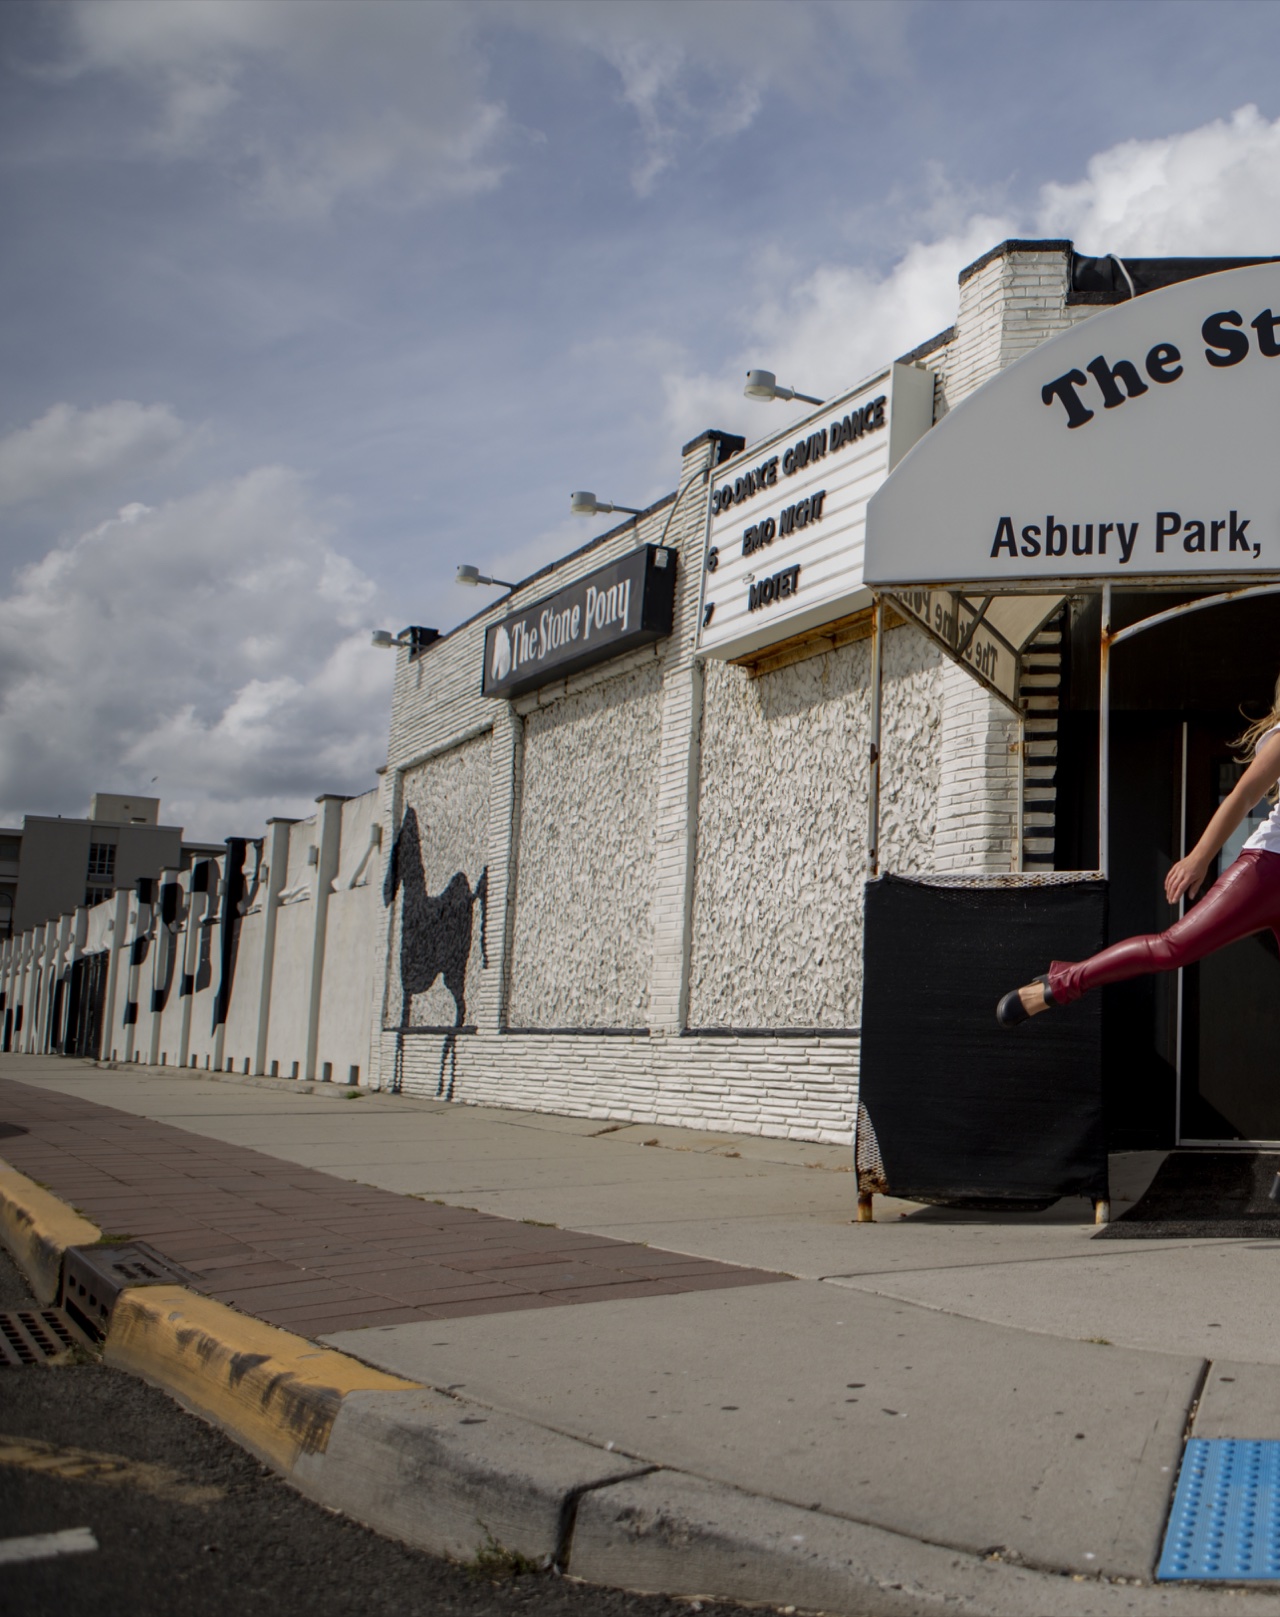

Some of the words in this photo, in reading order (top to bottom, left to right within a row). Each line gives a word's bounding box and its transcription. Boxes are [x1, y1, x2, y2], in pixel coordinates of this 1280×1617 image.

[1041, 343, 1184, 429] The
[782, 428, 827, 476] GAVIN
[830, 395, 887, 450] DANCE
[706, 546, 719, 573] 6
[742, 517, 776, 556] EMO
[779, 489, 827, 537] NIGHT
[990, 515, 1139, 564] Asbury
[1155, 510, 1262, 559] Park,
[512, 620, 538, 671] The
[538, 604, 581, 660] Stone
[584, 579, 631, 640] Pony
[748, 563, 801, 611] MOTET
